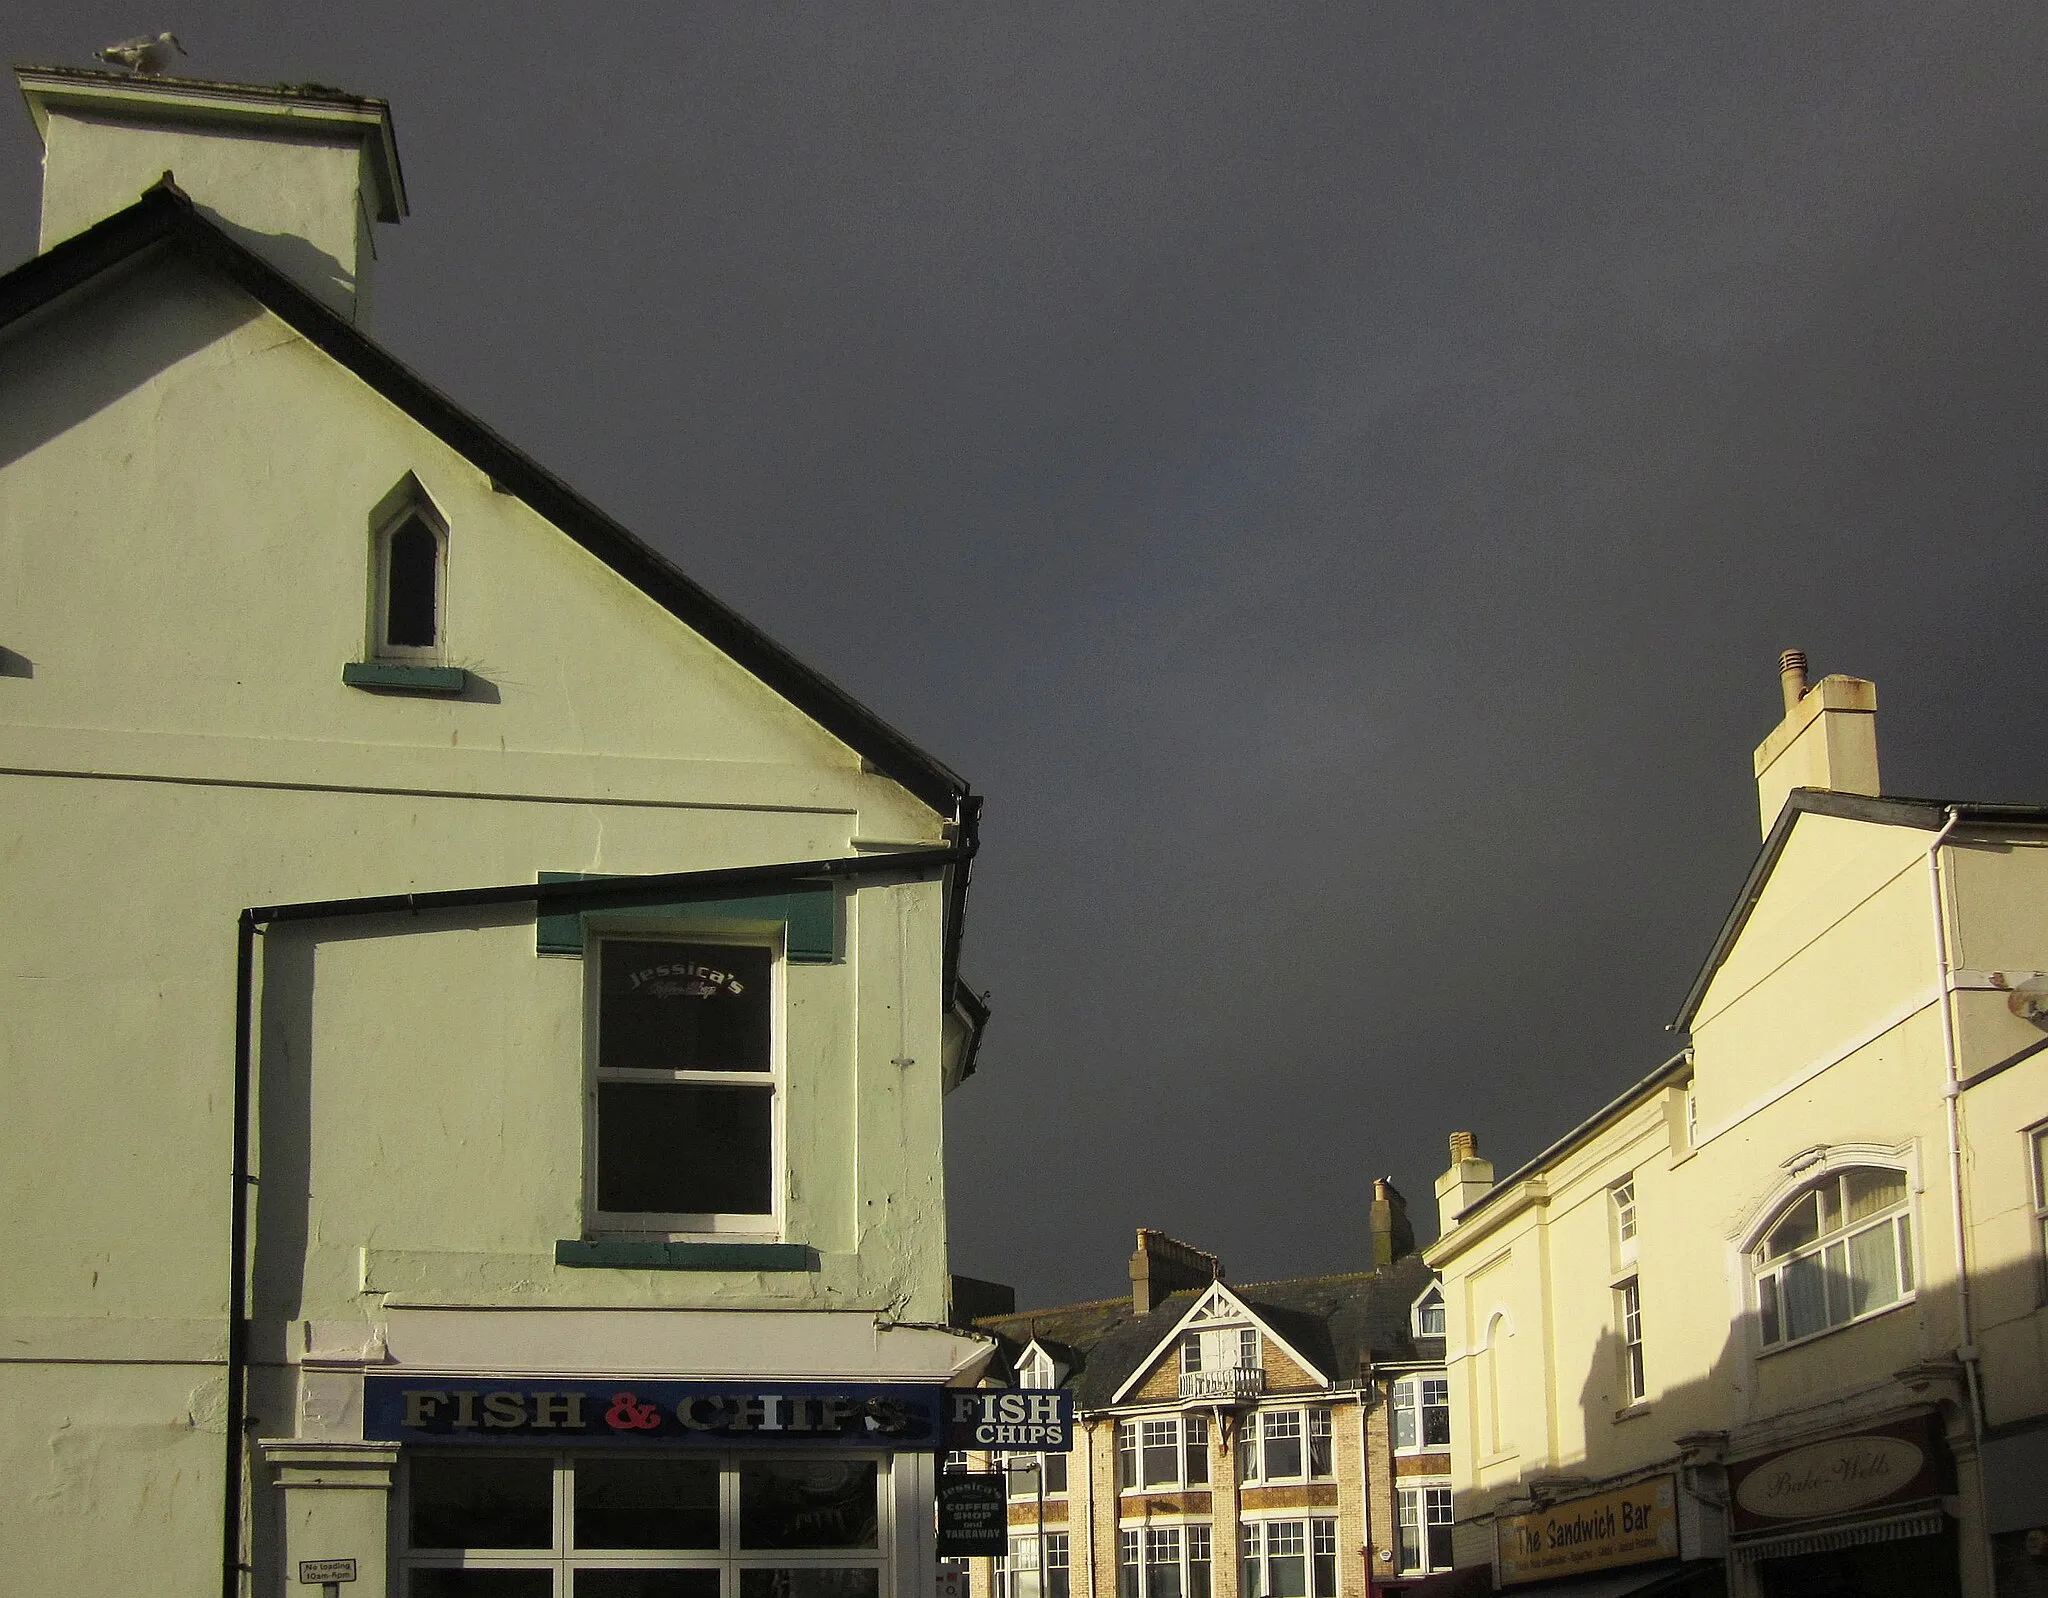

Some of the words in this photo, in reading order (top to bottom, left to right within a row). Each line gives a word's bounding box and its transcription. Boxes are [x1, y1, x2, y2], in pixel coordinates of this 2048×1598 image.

[629, 961, 745, 995] Jessica's
[401, 1391, 587, 1430] FISH
[604, 1391, 661, 1430] &
[676, 1394, 909, 1432] CHIPS
[952, 1393, 1061, 1424] FISH
[975, 1424, 1064, 1445] CHIPS
[941, 1482, 1003, 1500] Jessica's
[945, 1502, 999, 1512] COFFEE
[953, 1511, 992, 1520] SHOP
[963, 1520, 983, 1529] and
[1513, 1525, 1542, 1555] The
[1547, 1505, 1616, 1550] Sandwich
[1621, 1501, 1652, 1533] Bar
[945, 1529, 1000, 1540] TAKEAWAY
[320, 1562, 351, 1572] loading
